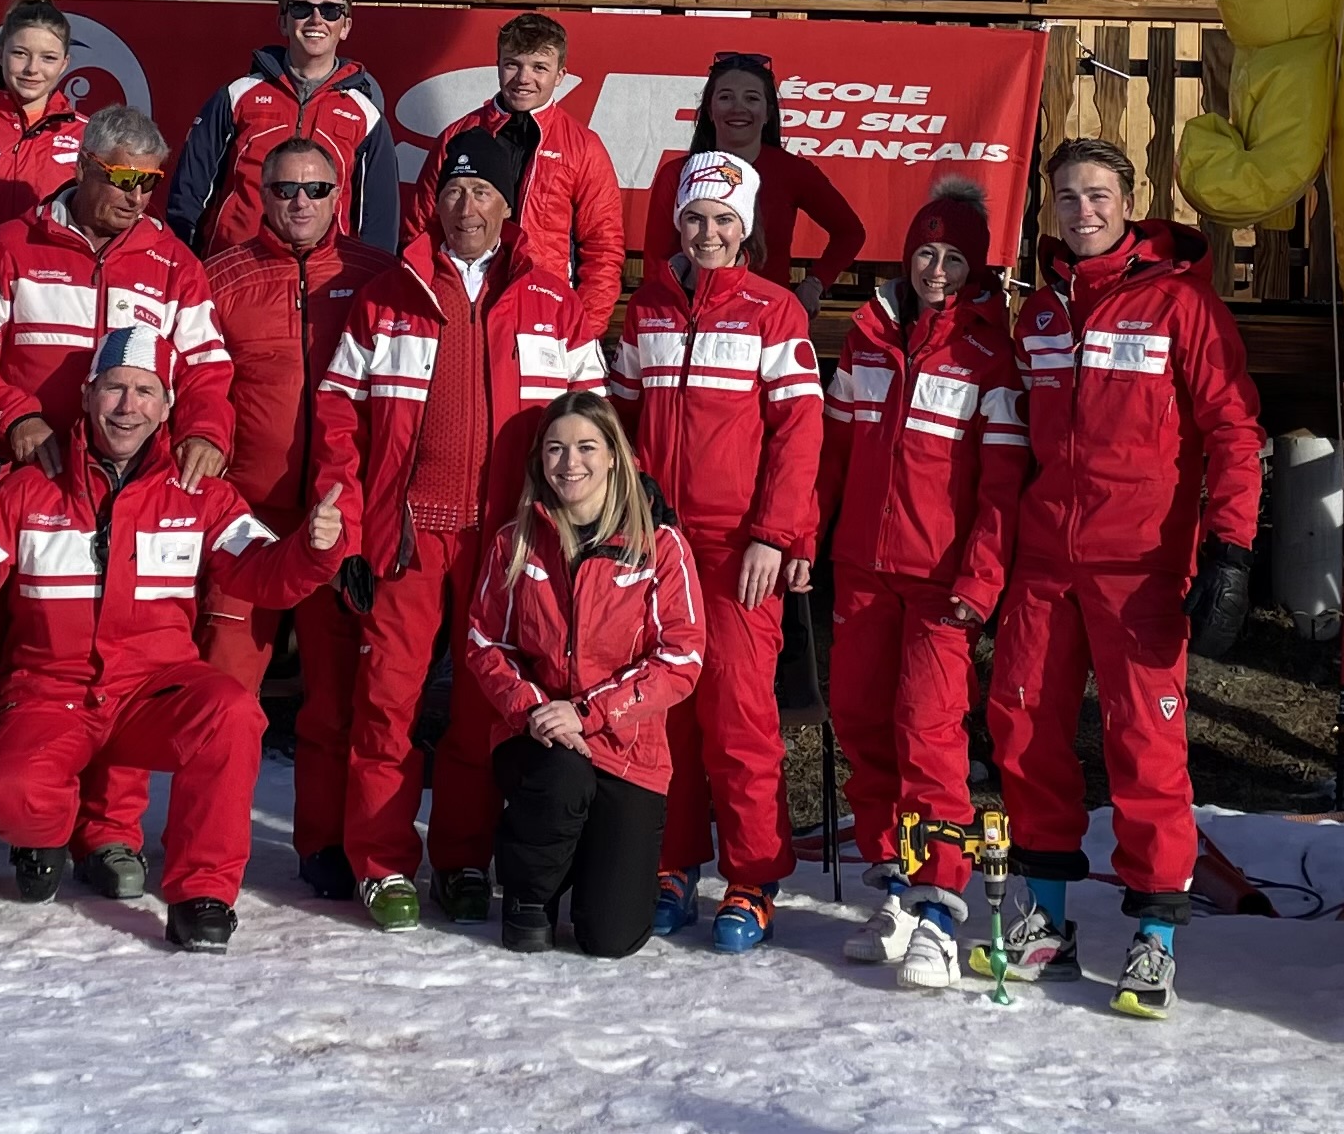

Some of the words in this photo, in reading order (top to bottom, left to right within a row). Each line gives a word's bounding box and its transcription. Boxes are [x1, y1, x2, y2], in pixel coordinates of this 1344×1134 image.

[254, 95, 273, 104] HH
[856, 112, 948, 135] SKI
[135, 307, 159, 327] AUL
